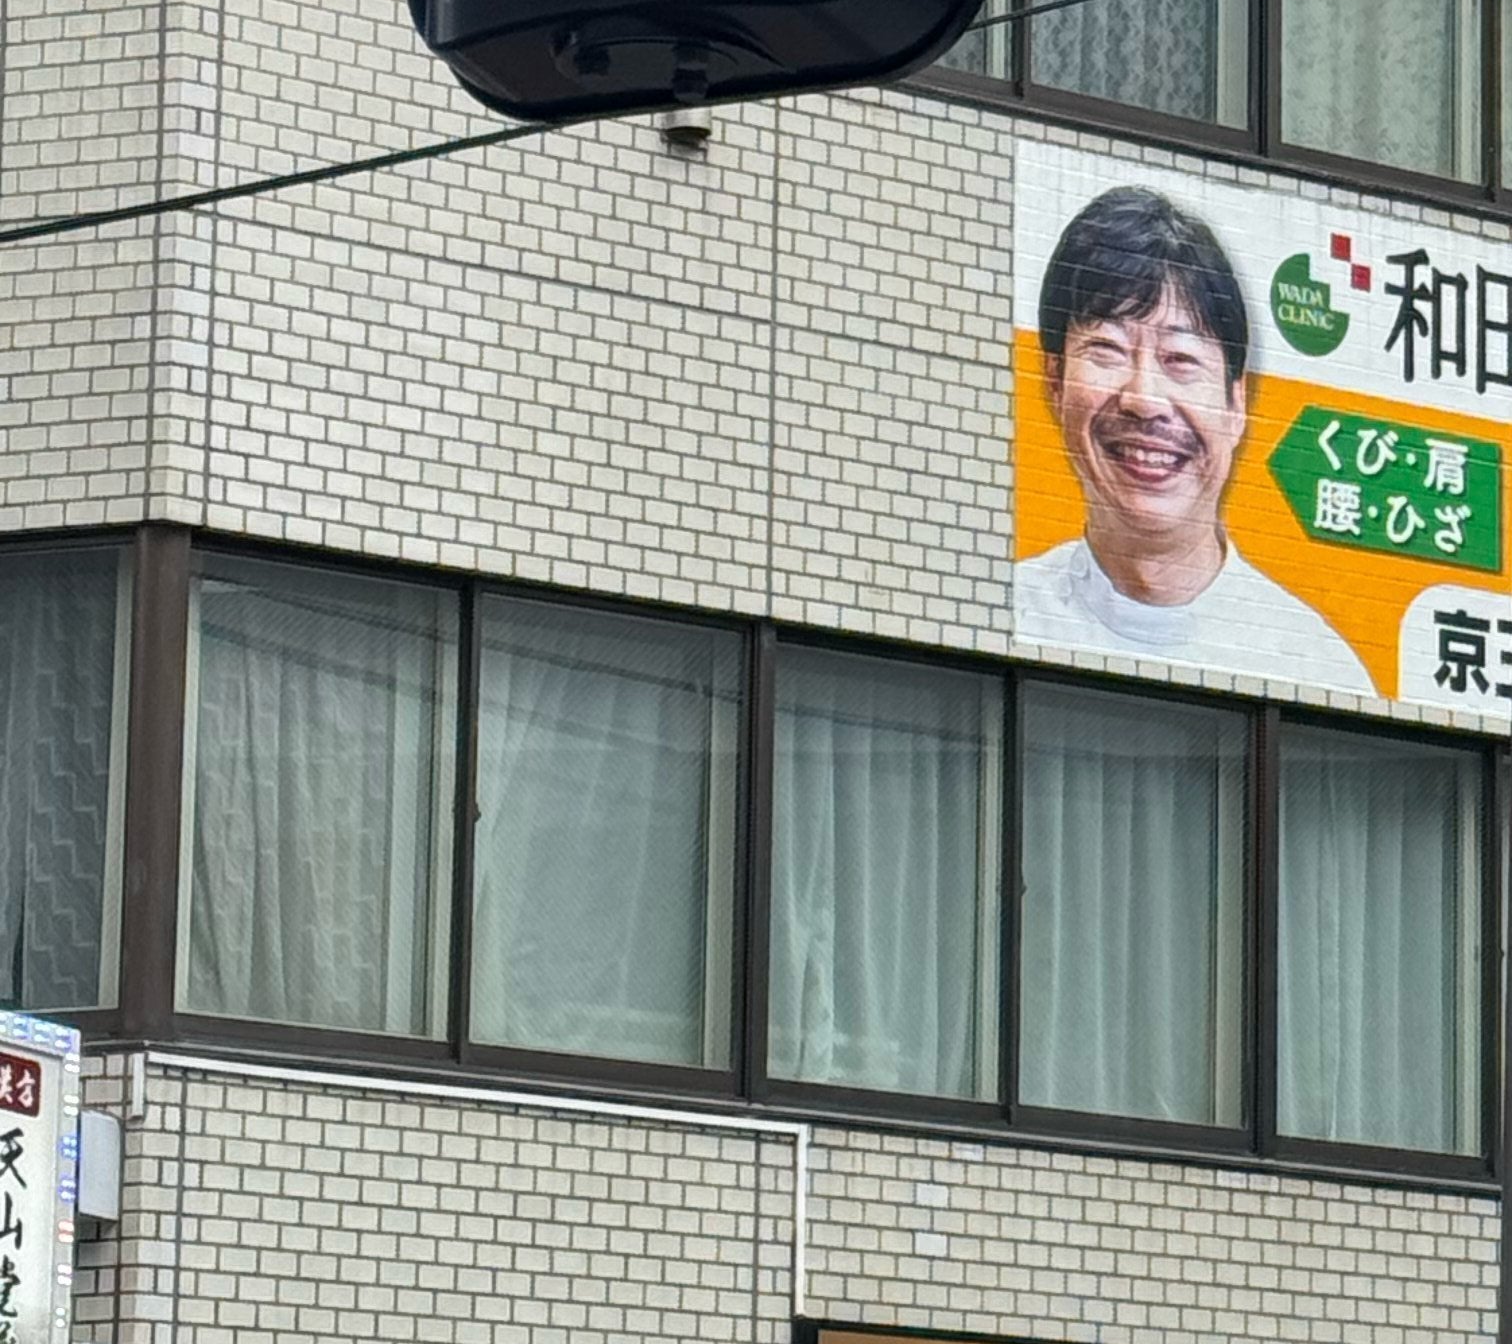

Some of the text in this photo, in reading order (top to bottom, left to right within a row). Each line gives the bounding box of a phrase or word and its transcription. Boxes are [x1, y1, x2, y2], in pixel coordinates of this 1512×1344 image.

[1278, 282, 1323, 305] WADA
[1278, 308, 1335, 331] CLINIC
[1318, 420, 1469, 495] くび・肩
[1314, 478, 1471, 553] 腰・ひざ
